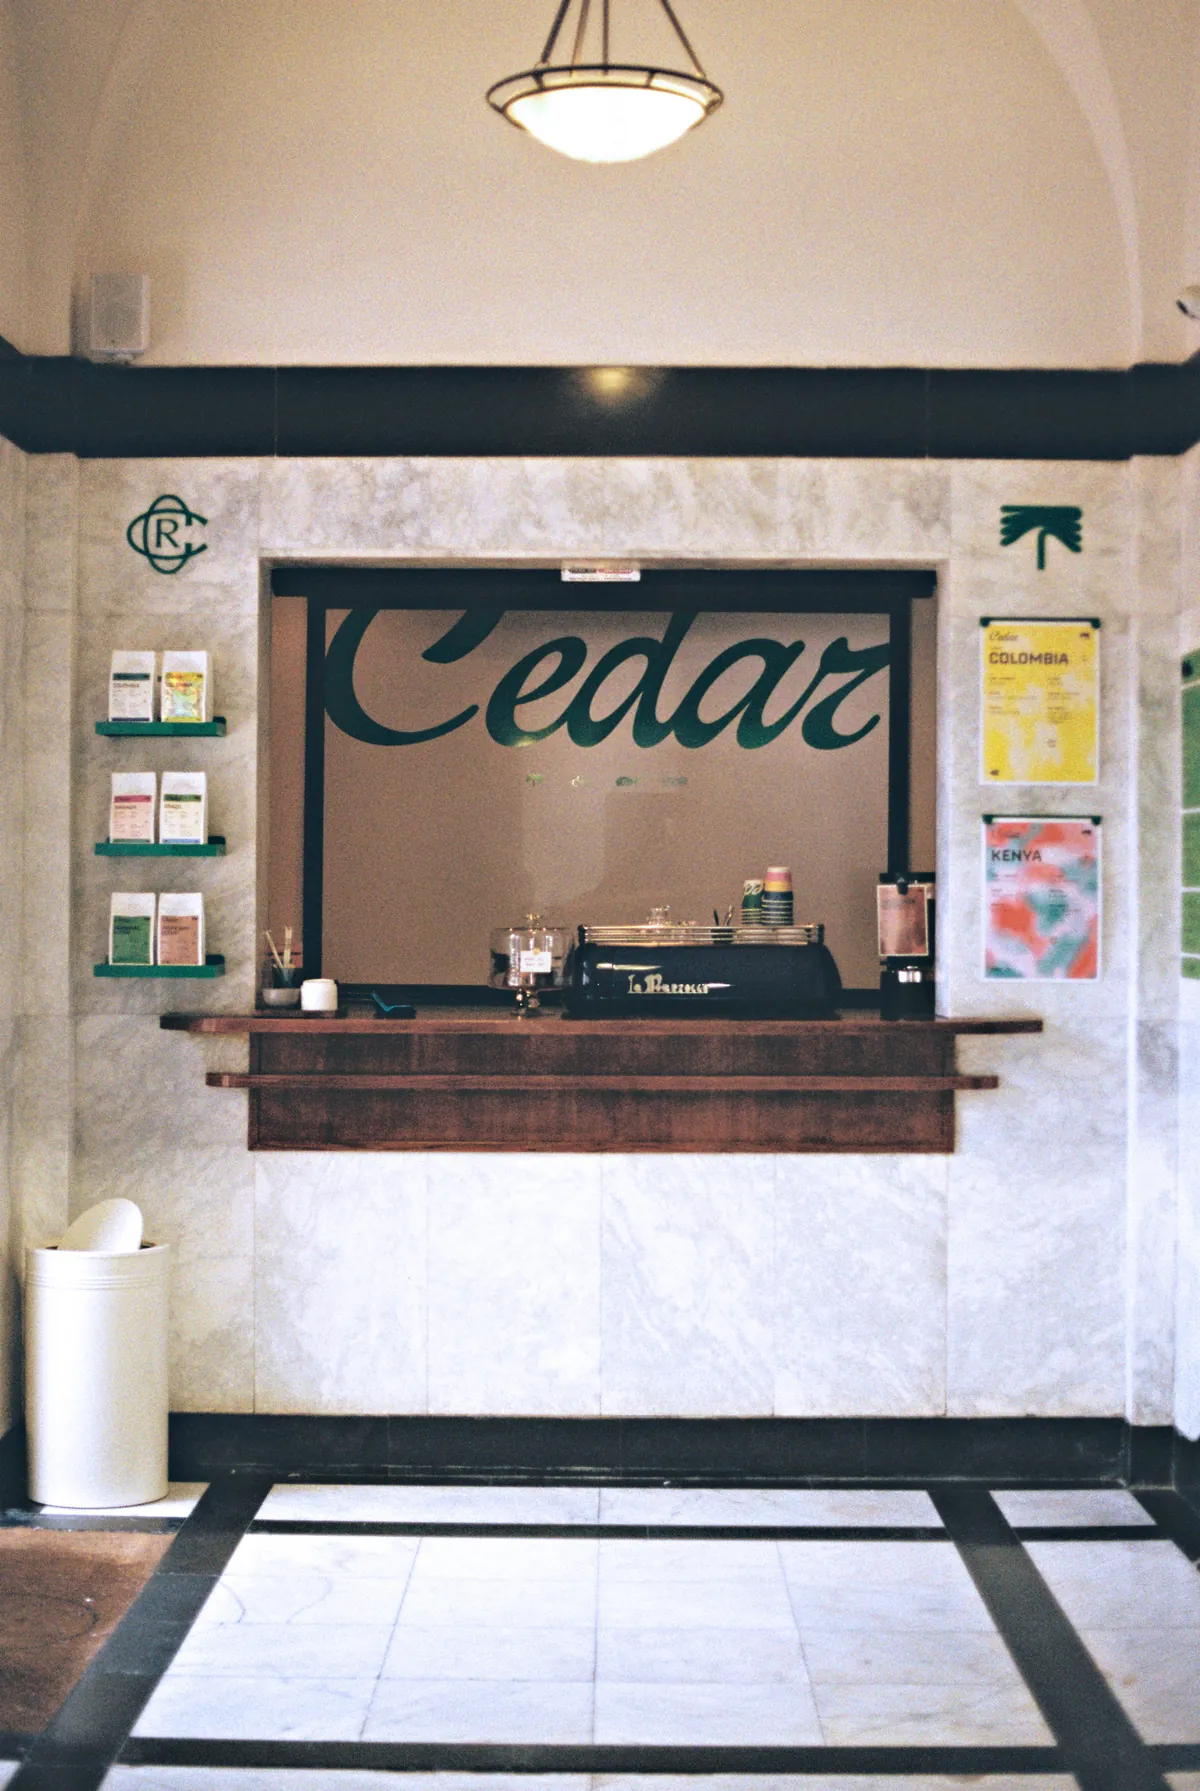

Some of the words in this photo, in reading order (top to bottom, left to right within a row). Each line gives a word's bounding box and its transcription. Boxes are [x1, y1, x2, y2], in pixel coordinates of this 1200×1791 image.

[989, 652, 1069, 665] COLOMBIA
[324, 609, 891, 751] Cedar
[991, 849, 1042, 862] KENYA
